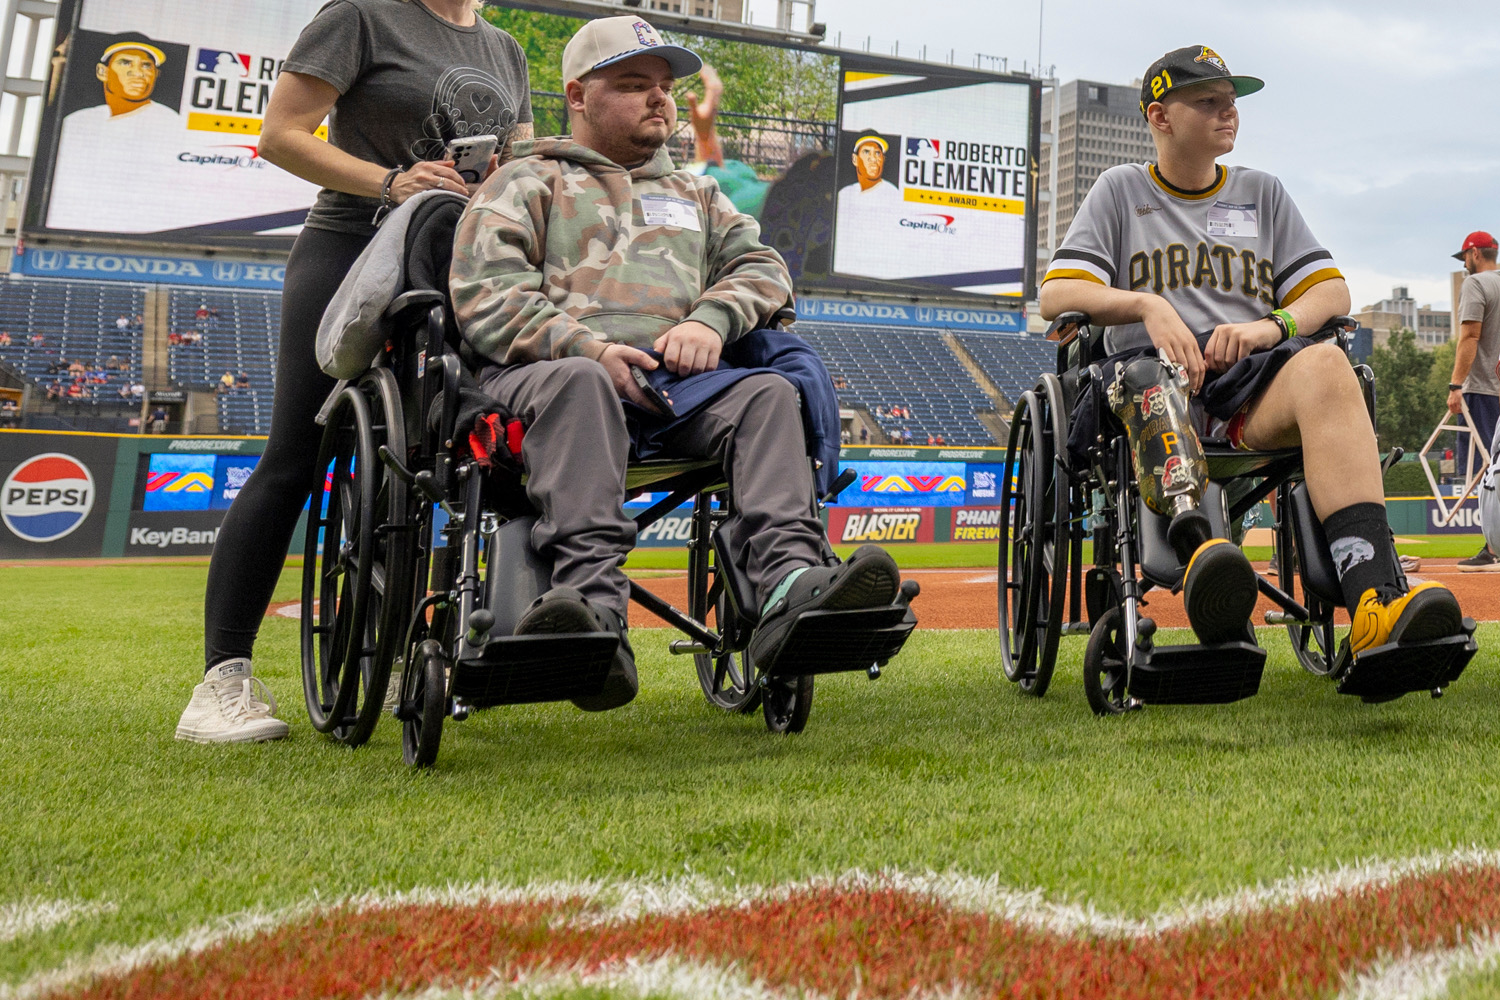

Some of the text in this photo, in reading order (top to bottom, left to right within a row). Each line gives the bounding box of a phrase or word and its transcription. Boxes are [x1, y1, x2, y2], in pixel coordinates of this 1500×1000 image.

[1151, 69, 1172, 99] 21
[946, 141, 1026, 167] ROBERTO
[904, 159, 1026, 197] CLEMENTE
[949, 196, 977, 207] AWARD
[66, 254, 202, 277] HONDA
[1129, 241, 1274, 308] PIRATES
[822, 302, 909, 319] HONDA
[936, 309, 1016, 326] HONDA
[168, 440, 244, 450] PROGRESSIVE
[1161, 431, 1178, 454] P
[869, 449, 918, 457] PROGRESSIVE
[938, 450, 985, 458] PROGRESSIVE
[8, 488, 87, 506] PEPSI
[841, 513, 921, 541] BLASTER
